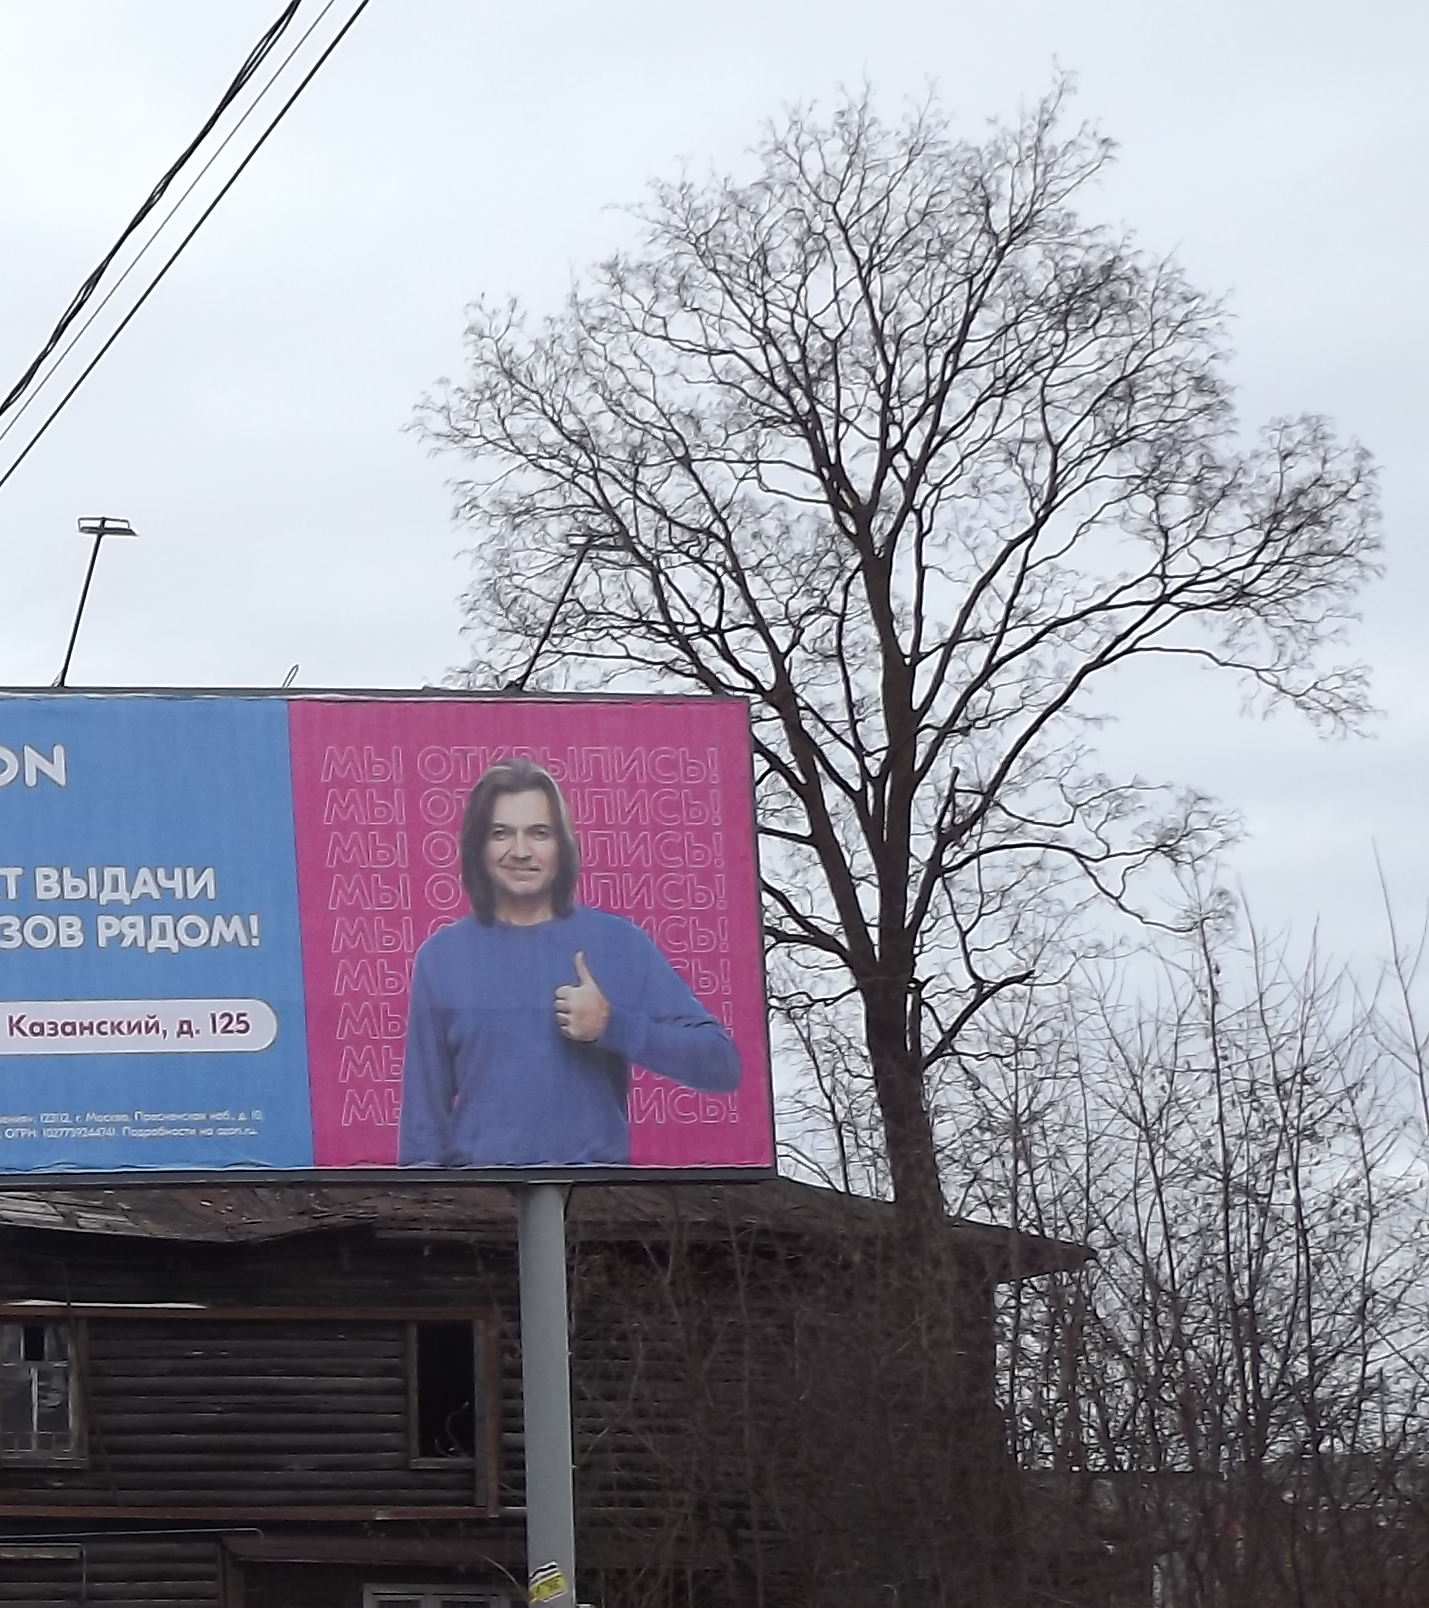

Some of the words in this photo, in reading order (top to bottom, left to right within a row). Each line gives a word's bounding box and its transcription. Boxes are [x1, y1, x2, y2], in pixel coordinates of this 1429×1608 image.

[321, 745, 403, 783] МЫ
[323, 788, 406, 825] МЫ
[326, 831, 408, 868] МЫ
[34, 866, 216, 906] ВЫДАЧИ
[328, 873, 411, 911] МЫ
[96, 913, 261, 954] РЯДОМ!
[331, 916, 414, 953] МЫ
[7, 1013, 168, 1040] Казанский,
[176, 1017, 201, 1040] д.
[210, 1011, 252, 1035] 125
